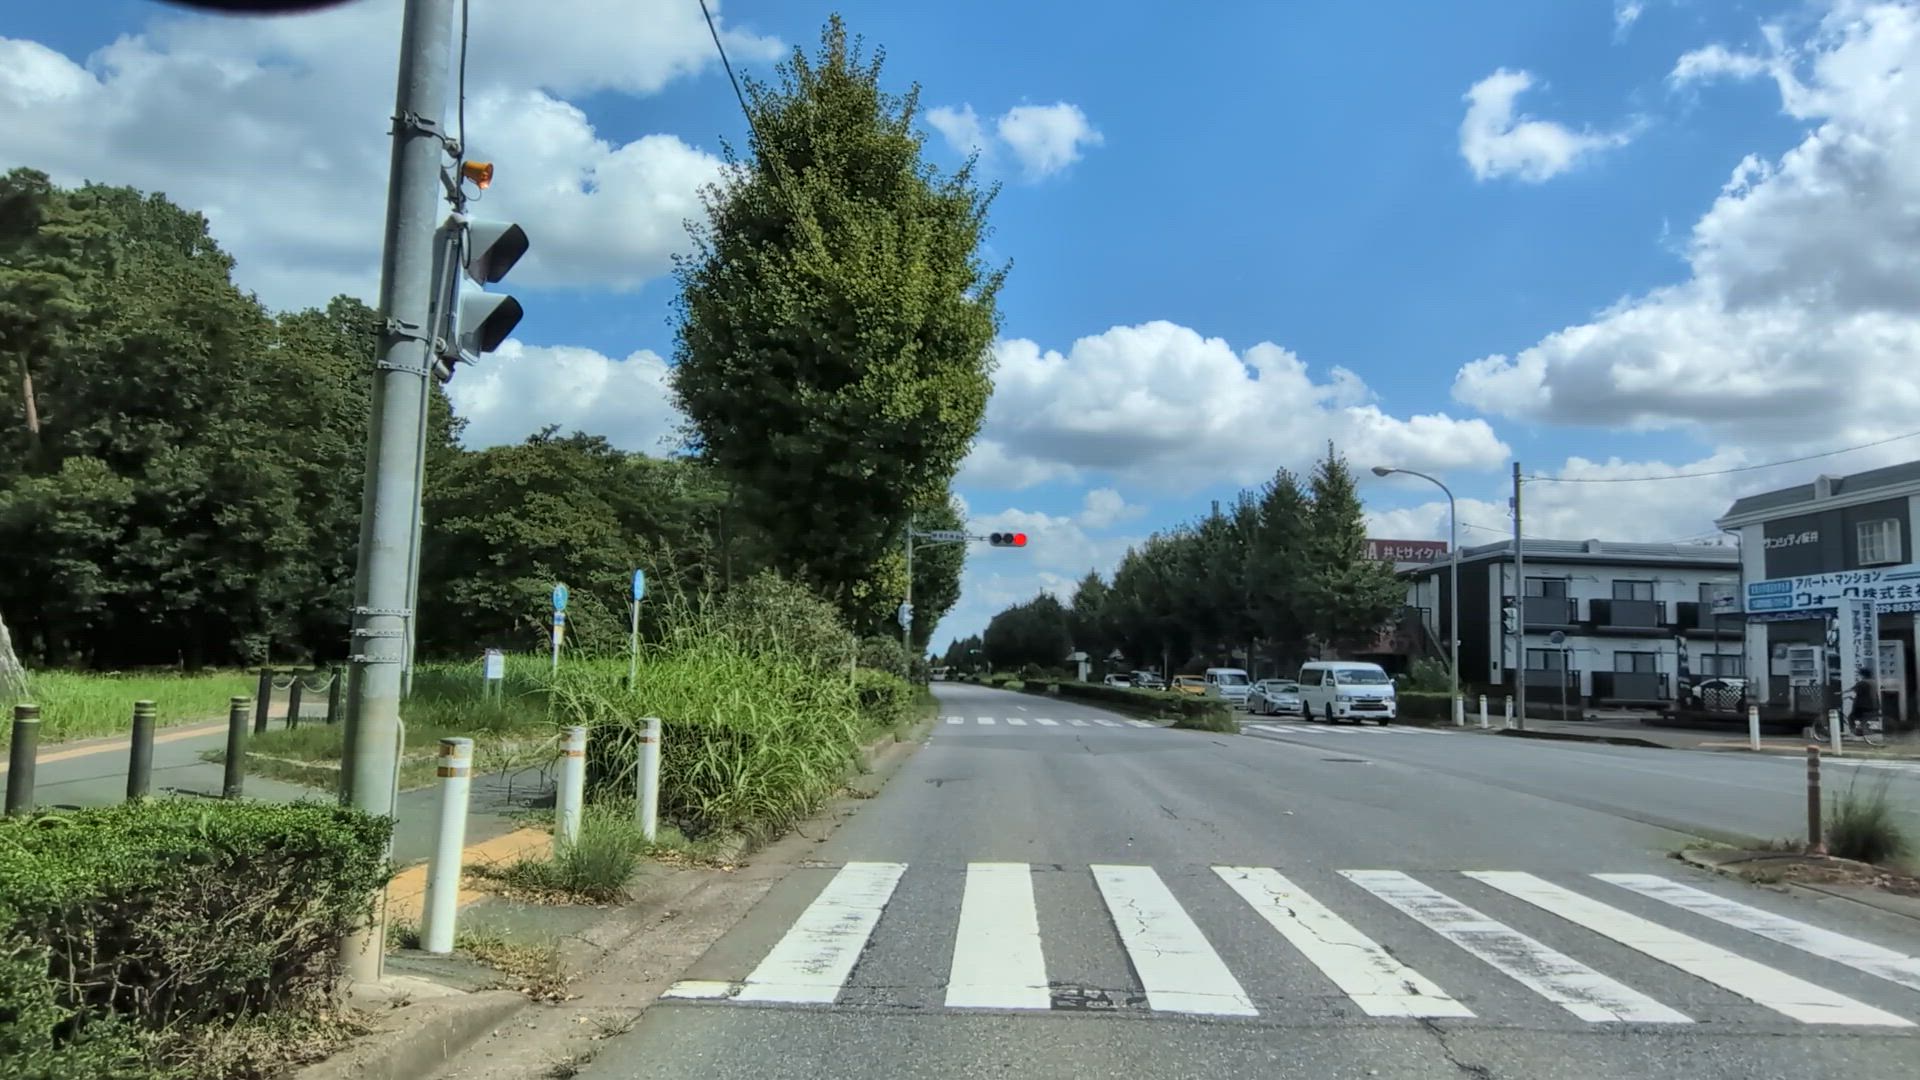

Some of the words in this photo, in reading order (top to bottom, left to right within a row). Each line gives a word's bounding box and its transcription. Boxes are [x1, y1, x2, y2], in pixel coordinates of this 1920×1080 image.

[1795, 572, 1881, 589] アパート・マンション
